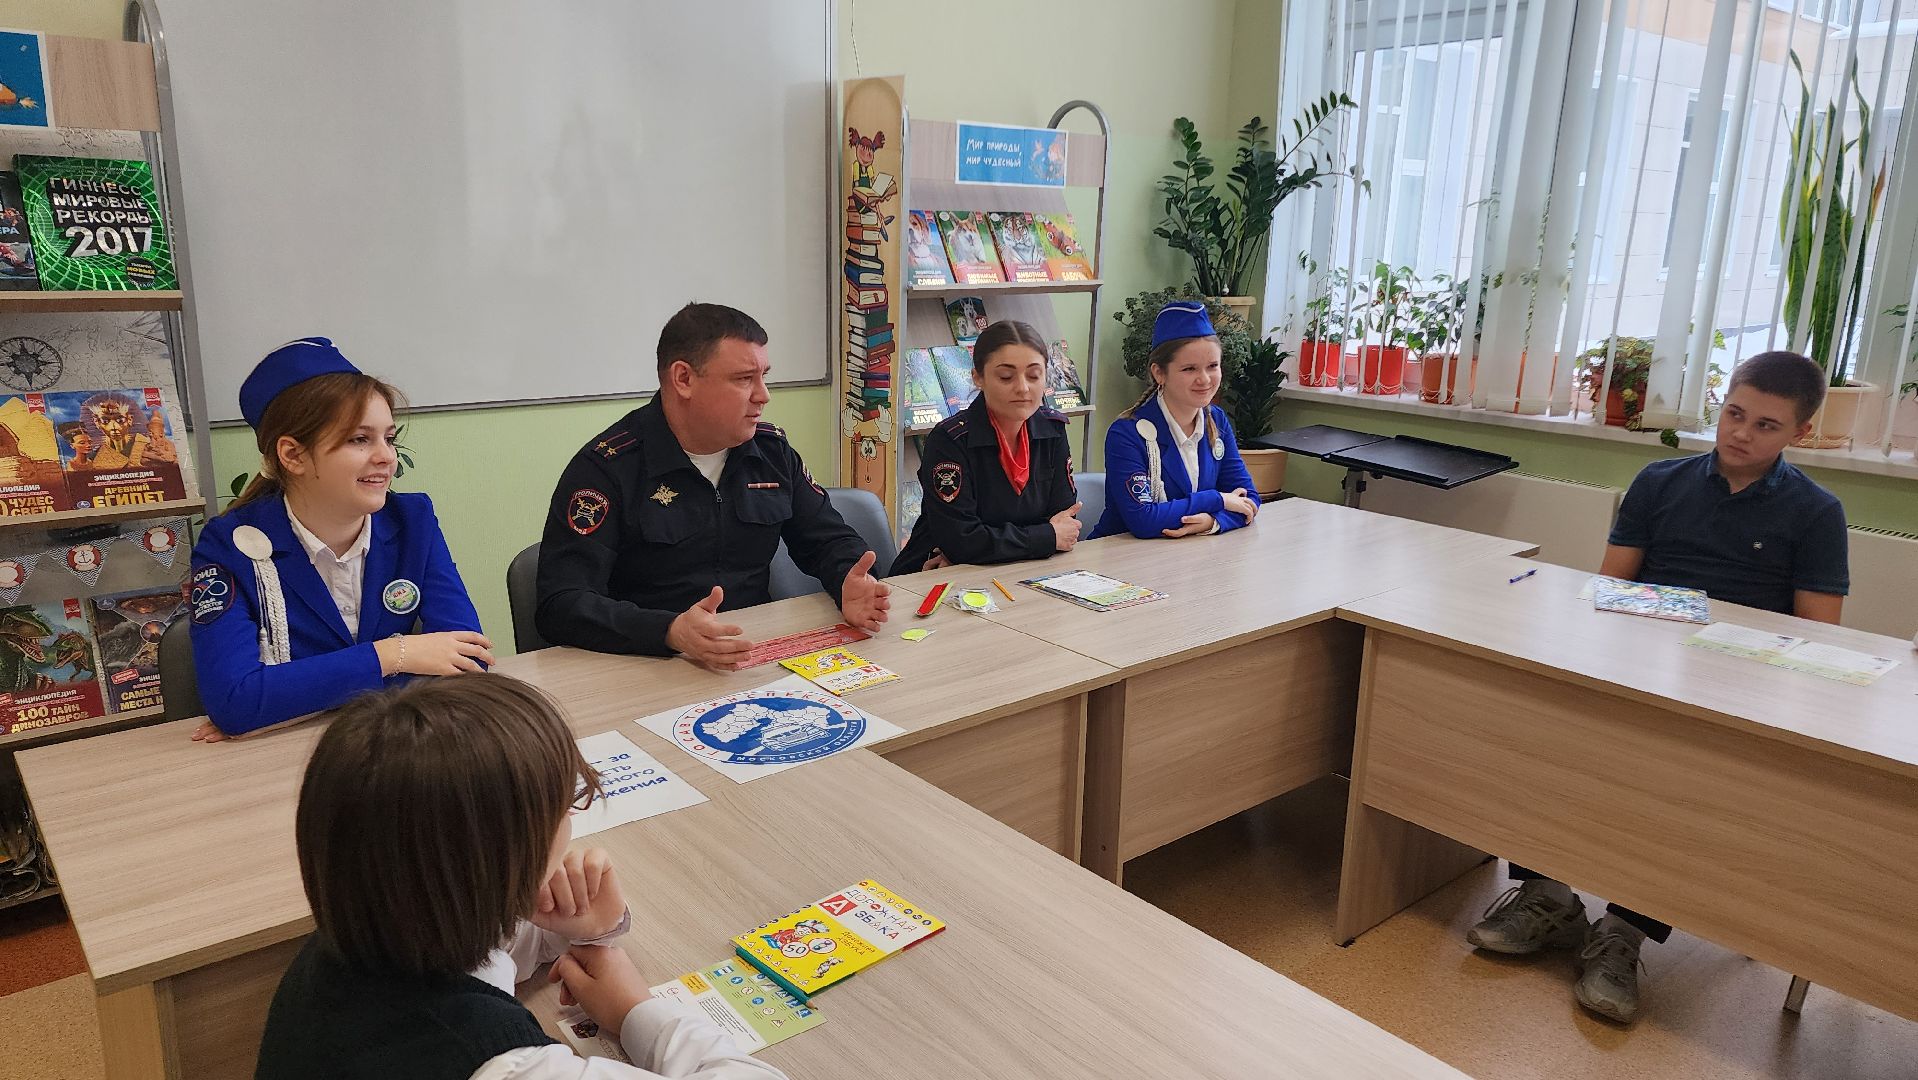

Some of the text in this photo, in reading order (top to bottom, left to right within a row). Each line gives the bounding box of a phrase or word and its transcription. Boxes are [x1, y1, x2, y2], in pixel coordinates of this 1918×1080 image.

[967, 138, 1022, 156] Мир природы,
[966, 156, 1021, 167] мир чудесный
[50, 177, 142, 196] ГИННЕСС
[52, 193, 148, 210] МИРОВЫЕ
[56, 209, 153, 225] РЕКОРДЫ
[65, 226, 153, 257] 2017
[94, 470, 154, 481] ЭНЦИКЛОПЕДИЯ
[104, 482, 150, 494] ДРЕВНИЙ
[9, 495, 54, 507] ЧУДЕС
[93, 491, 164, 508] ЕГИПЕТ
[11, 505, 56, 517] СВЕТА
[193, 567, 218, 583] ЮИД
[15, 689, 77, 705] ЭНЦИКЛОПЕДИЯ
[120, 697, 154, 711] МЕСТА
[17, 705, 49, 722] 100
[51, 703, 80, 717] ТАЙН
[11, 711, 89, 734] ДИНОЗАВРОВ
[784, 943, 807, 955] 50
